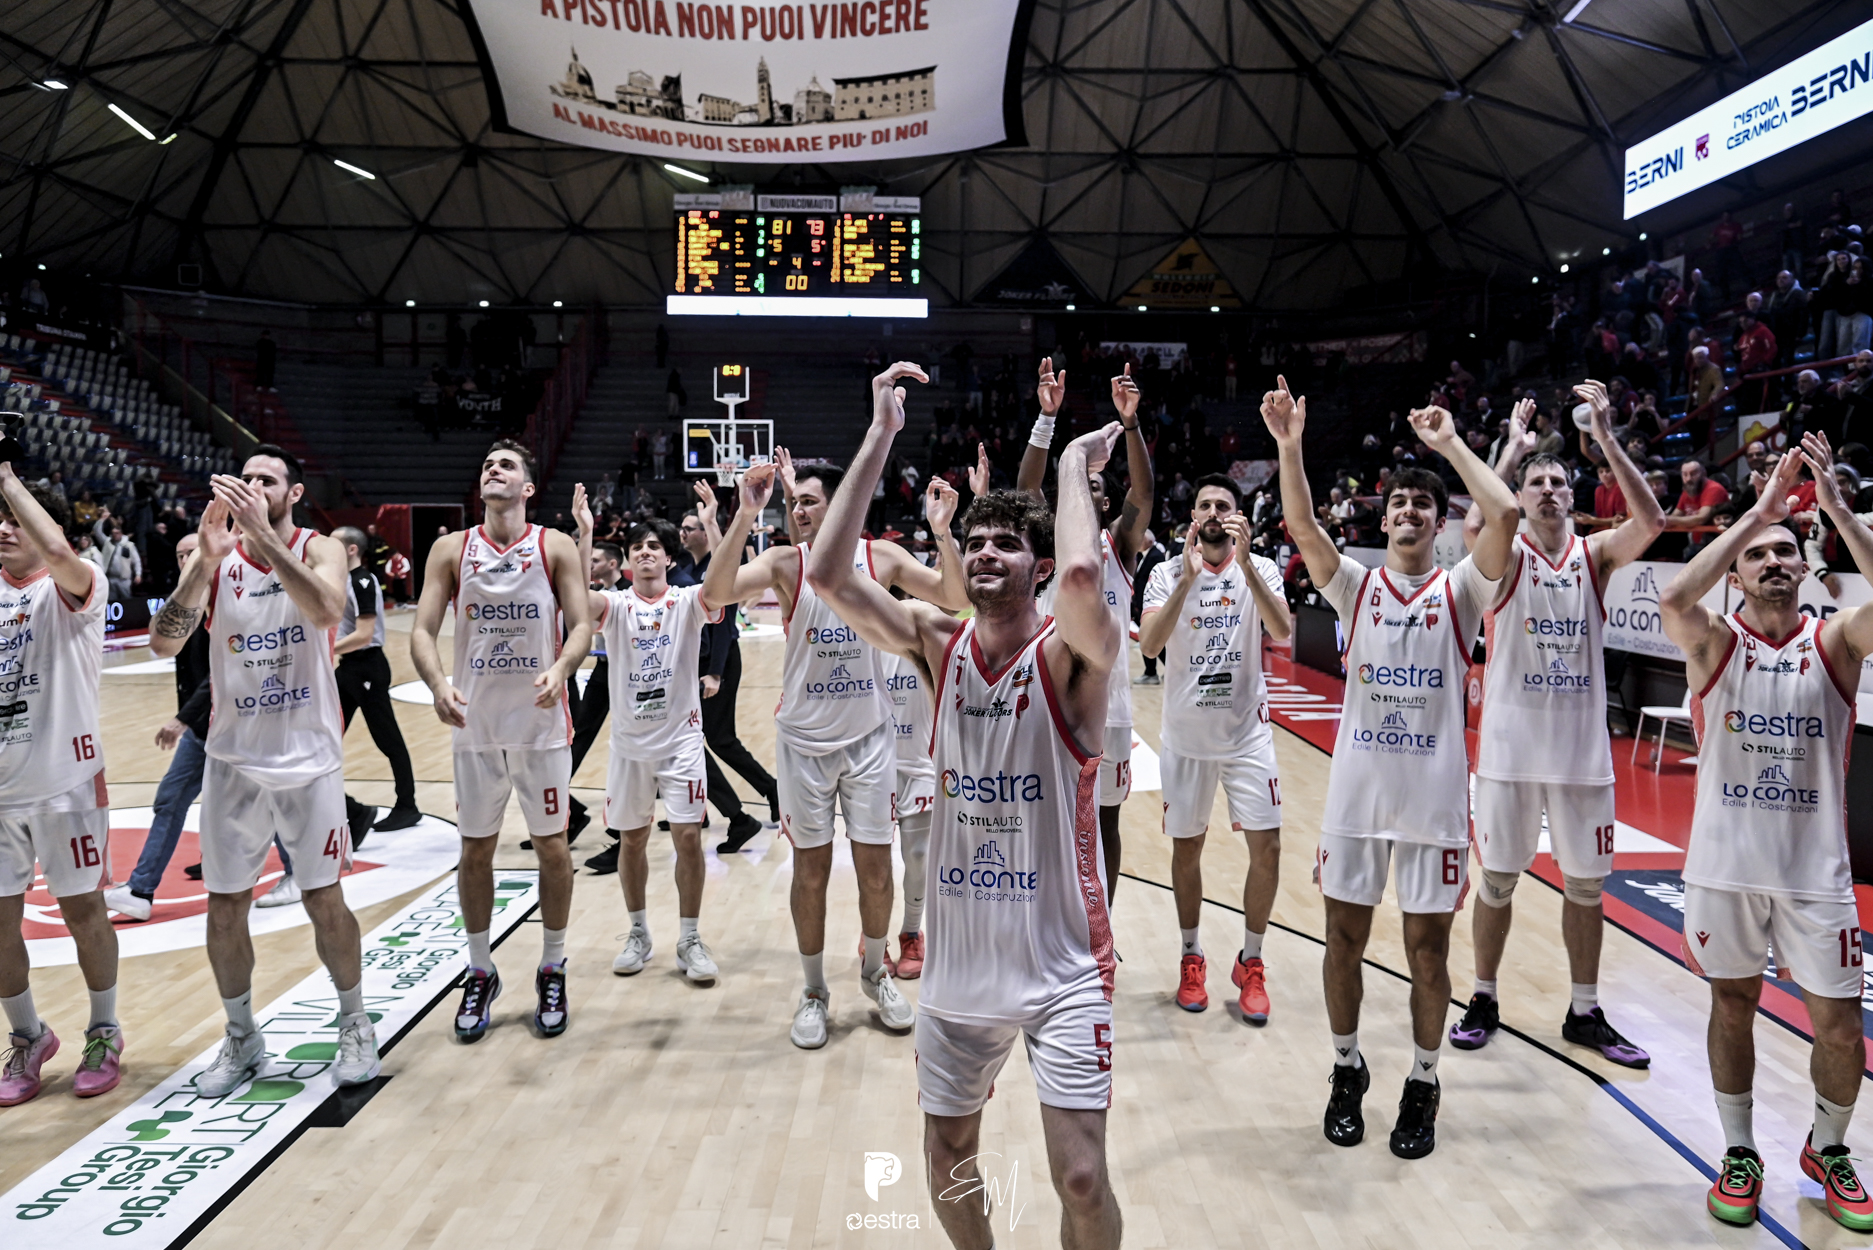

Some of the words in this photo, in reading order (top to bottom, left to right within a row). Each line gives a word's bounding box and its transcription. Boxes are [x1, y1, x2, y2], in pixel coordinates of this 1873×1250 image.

[564, 0, 672, 37] PISTOIA
[677, 2, 735, 41] NON
[742, 5, 804, 42] PUOI
[810, 0, 930, 39] VINCERE
[1791, 51, 1873, 118] BERN
[1733, 95, 1780, 129] PISTOIA
[552, 102, 577, 125] AL
[578, 111, 673, 146] MASSIMO
[675, 131, 724, 152] PUOI
[727, 135, 823, 153] SEGNARE
[871, 128, 890, 145] DI
[895, 120, 928, 141] NOI
[1726, 111, 1788, 150] CERAMICA
[1626, 146, 1684, 194] BERNI
[772, 219, 792, 235] 81
[806, 219, 825, 236] 73
[792, 257, 802, 269] 4
[785, 275, 808, 290] 00
[1151, 281, 1215, 294] SEDONI
[228, 564, 243, 581] 41
[1371, 587, 1381, 606] 6
[481, 601, 541, 620] estra
[1609, 606, 1627, 628] LO
[1630, 610, 1662, 634] CON
[247, 625, 306, 651] estra
[470, 657, 485, 669] LO
[488, 657, 538, 669] CONTE
[828, 648, 861, 658] STILAUTO
[1190, 656, 1204, 665] LO
[629, 671, 641, 682] LO
[806, 682, 824, 693] LO
[827, 678, 874, 694] CONTE
[887, 673, 918, 691] stra
[1376, 664, 1443, 688] estra
[1525, 673, 1543, 685] LO
[1547, 675, 1591, 687] CONTE
[235, 697, 256, 709] LO
[259, 687, 311, 707] CONTE
[806, 693, 824, 701] Edile
[1204, 699, 1233, 707] STILAUTO
[1383, 694, 1427, 705] STILAUTO
[1748, 712, 1825, 738] estra
[72, 734, 95, 762] 16
[1352, 743, 1371, 752] Edile
[1381, 745, 1436, 757] Costruzioni
[1353, 729, 1373, 742] LO
[1376, 732, 1436, 749] CONTE
[1757, 744, 1806, 756] STILAUTO
[688, 779, 706, 804] 14
[961, 770, 1044, 804] estra
[1724, 783, 1748, 798] LO
[1753, 787, 1818, 805] CONTE
[544, 787, 559, 815] 9
[1722, 797, 1747, 808] Edile
[1759, 801, 1818, 813] Costruzioni
[969, 816, 1023, 827] STILAUTO
[1596, 824, 1614, 856] 18
[71, 835, 100, 869] 16
[940, 865, 964, 885] LO
[969, 869, 1037, 890] CONTE
[1442, 849, 1459, 885] 6
[939, 885, 963, 898] Edile
[1838, 927, 1862, 968] 15
[377, 948, 428, 970] Tesi
[391, 948, 459, 989] Giorgio
[1093, 1023, 1113, 1072] 5
[97, 1145, 191, 1191] Tesi
[16, 1145, 142, 1220] Group
[102, 1146, 235, 1236] Giorgio
